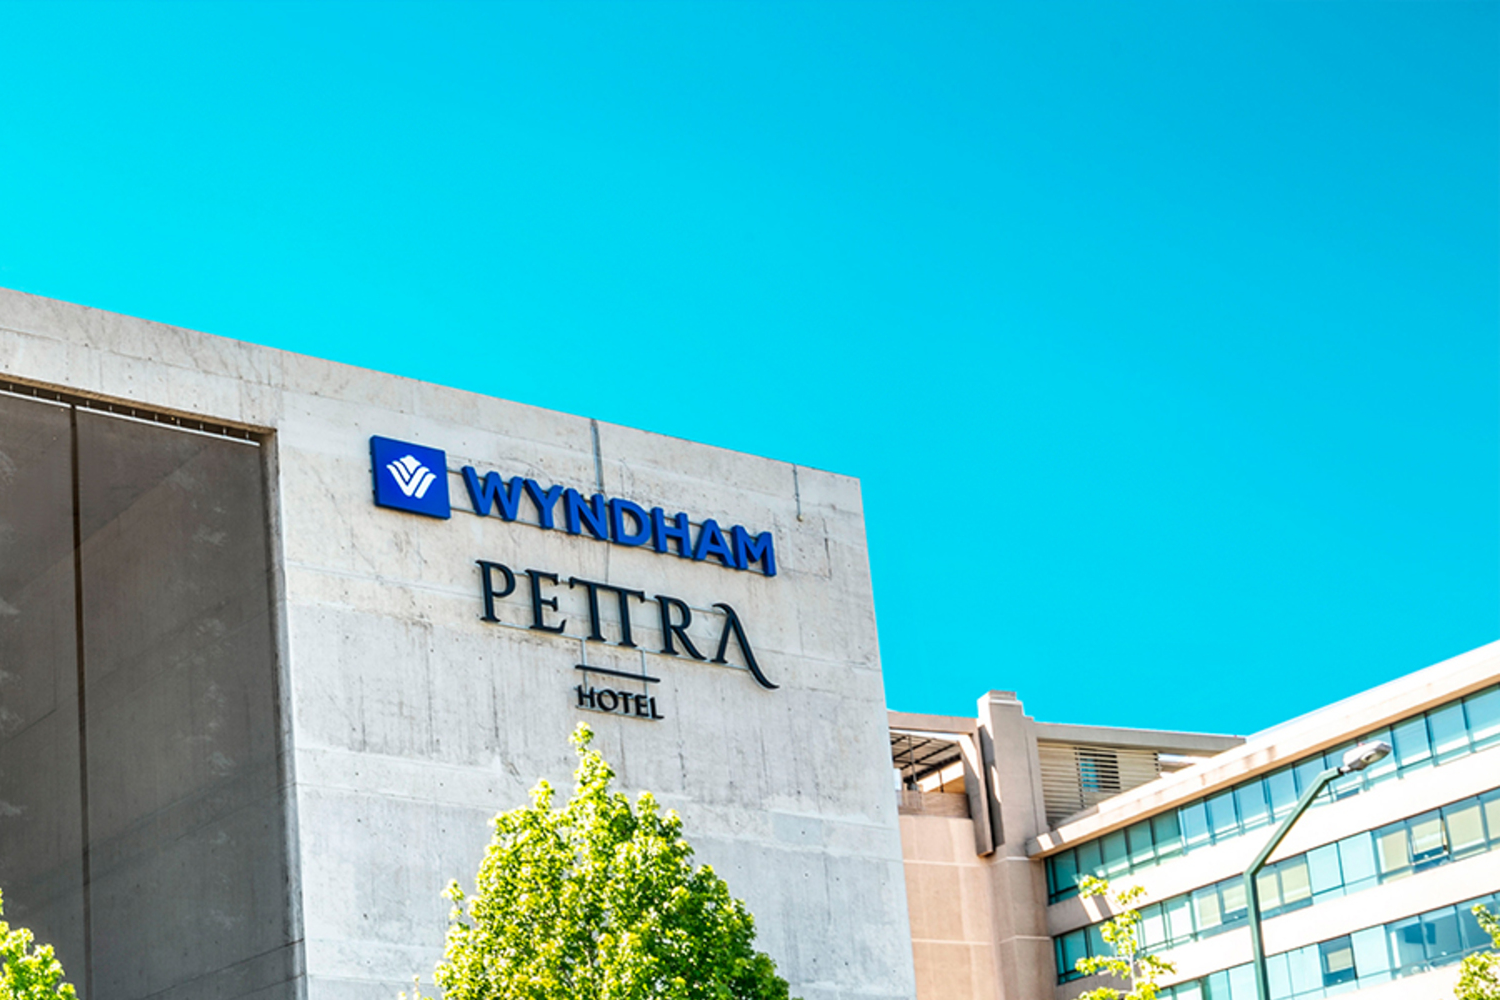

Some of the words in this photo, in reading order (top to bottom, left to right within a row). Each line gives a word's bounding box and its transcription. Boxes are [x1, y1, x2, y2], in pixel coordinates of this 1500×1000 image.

[461, 465, 777, 577] WYNDHAM
[475, 559, 780, 690] PETTRA
[577, 684, 665, 719] HOTEL
